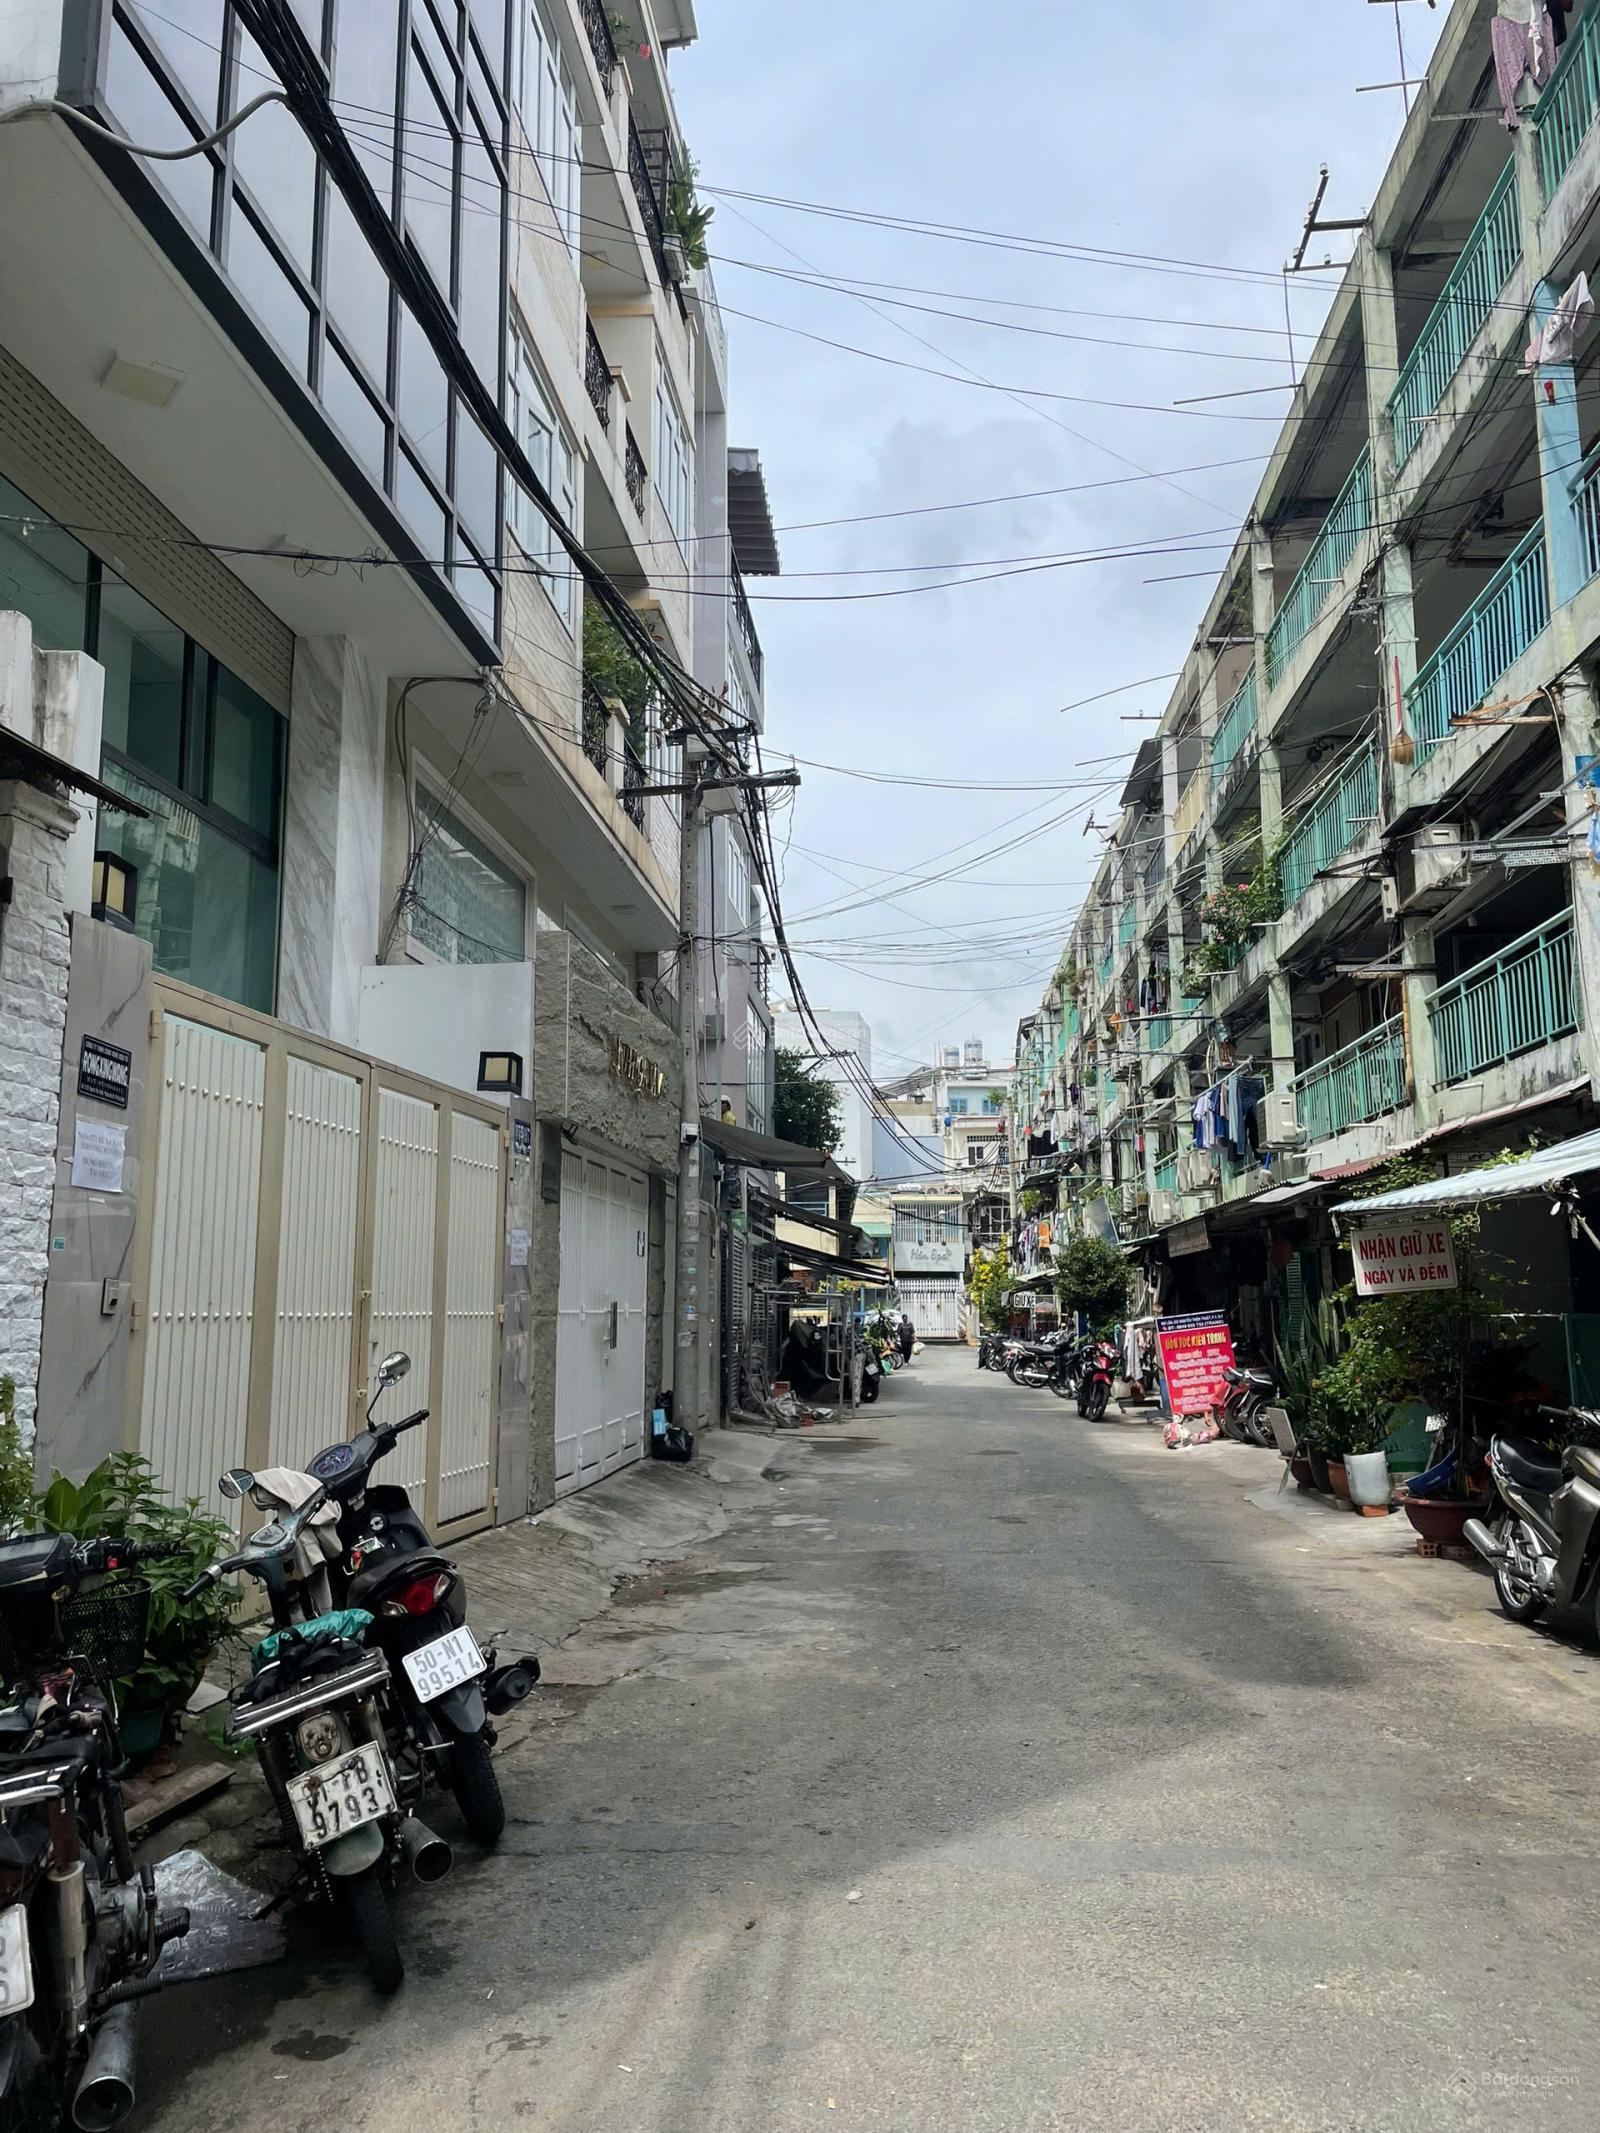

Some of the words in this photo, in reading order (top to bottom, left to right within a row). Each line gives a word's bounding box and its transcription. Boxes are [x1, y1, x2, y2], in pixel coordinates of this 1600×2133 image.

[1359, 1232, 1396, 1264] NHẬN
[1400, 1230, 1422, 1257] GIỮ
[1427, 1231, 1446, 1255] XE
[1364, 1265, 1395, 1286] NGÀY
[1399, 1264, 1416, 1282] VÀ
[1420, 1262, 1449, 1281] ĐÊM
[414, 1635, 465, 1674] 50-N1
[418, 1651, 481, 1697] 995.14
[311, 1786, 379, 1840] 9793
